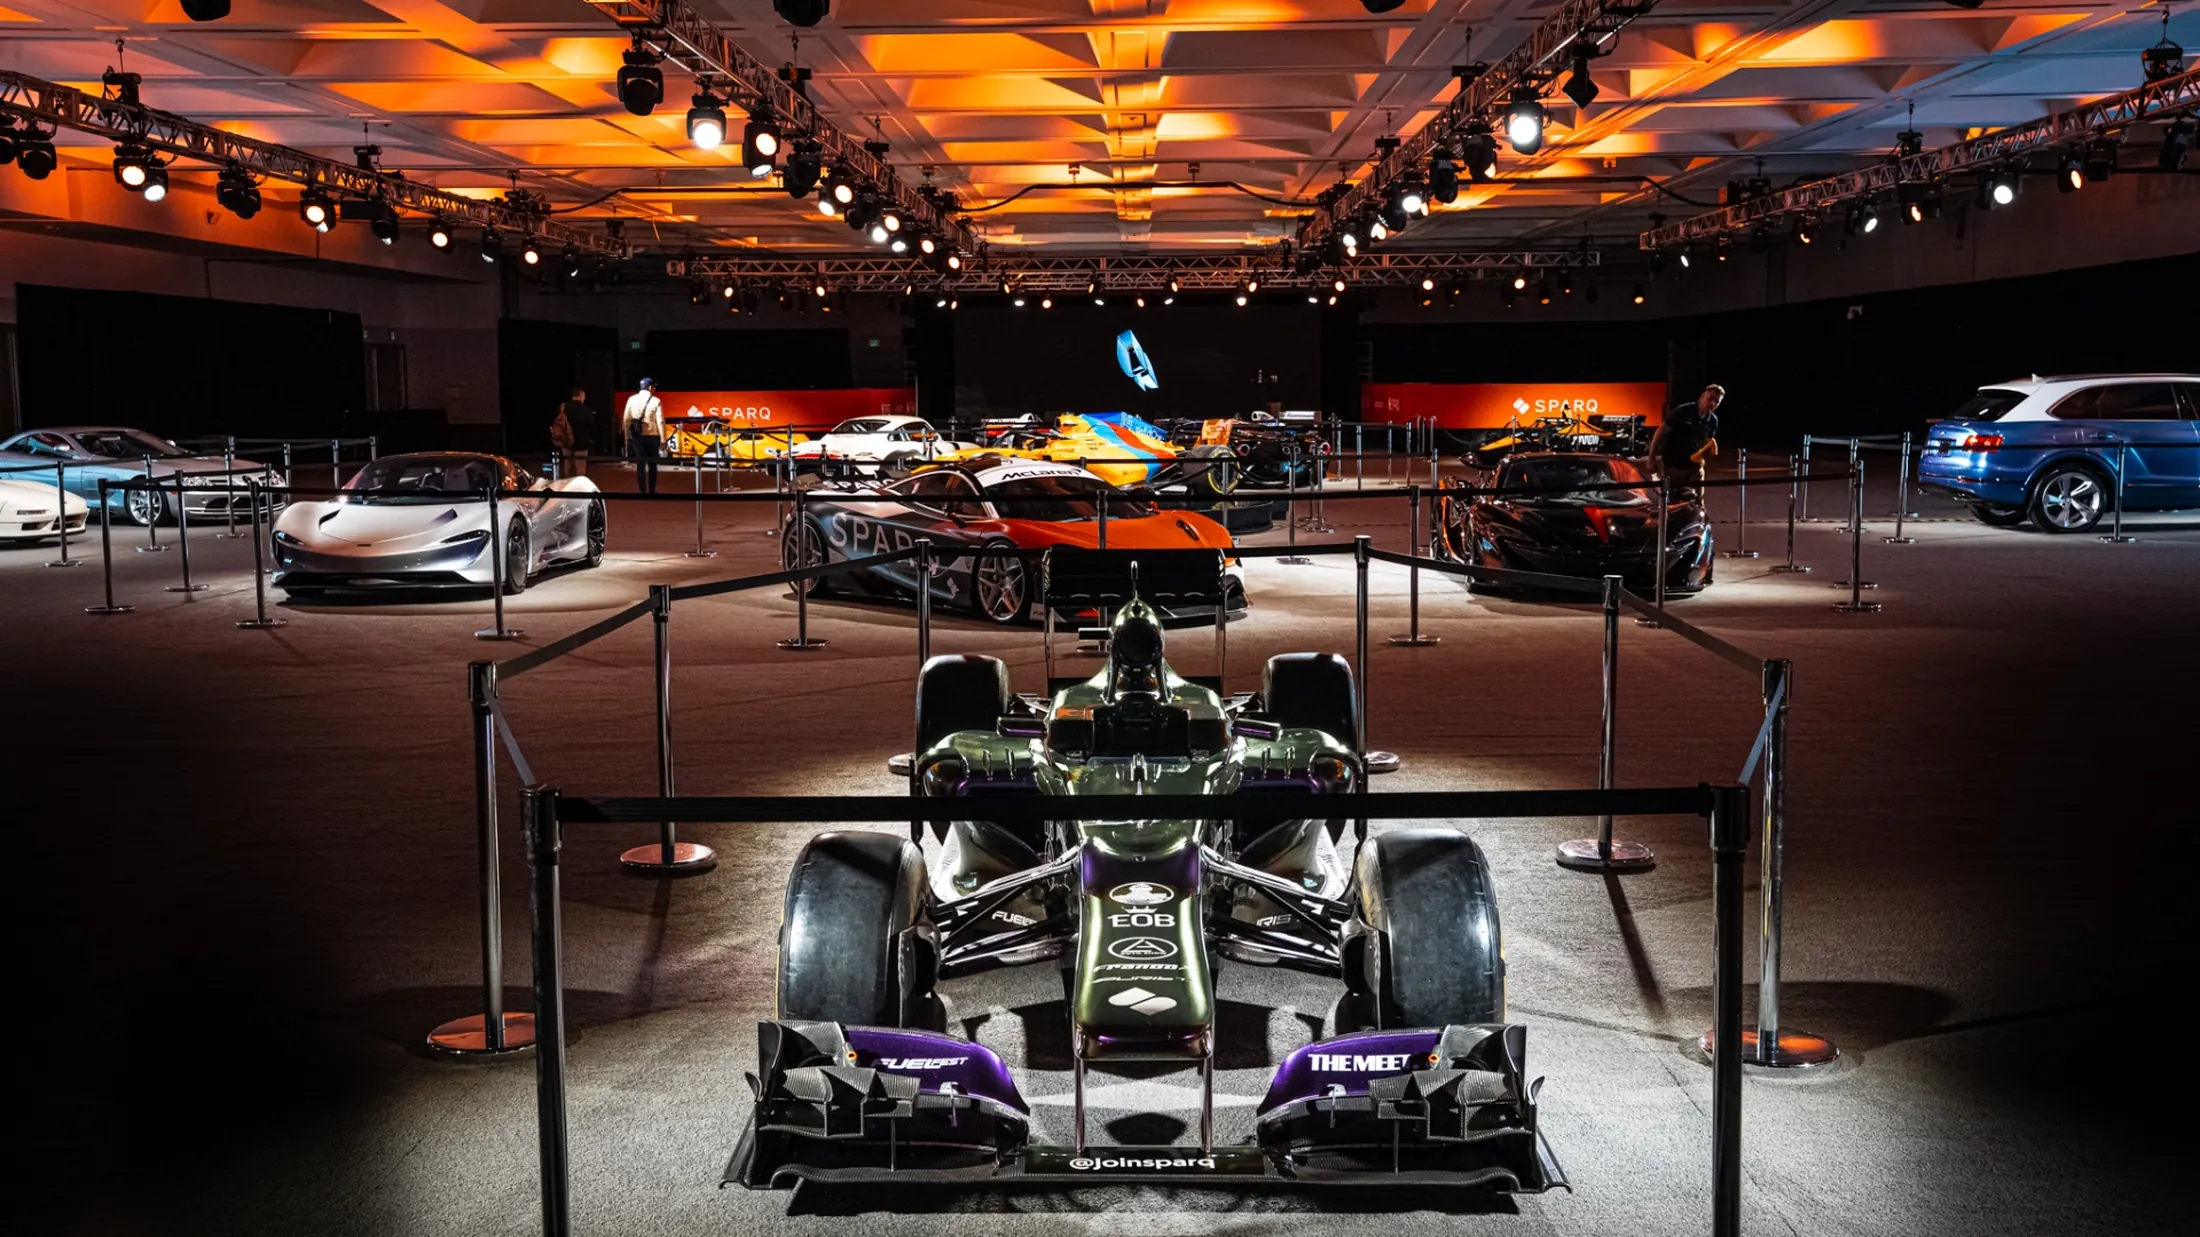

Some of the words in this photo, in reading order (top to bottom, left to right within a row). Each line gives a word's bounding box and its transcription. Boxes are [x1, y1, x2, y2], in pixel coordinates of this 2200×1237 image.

[1534, 399, 1599, 413] SPARQ
[708, 406, 772, 421] SPARQ
[1002, 468, 1082, 480] McLaren
[829, 511, 930, 570] SPAR
[1107, 913, 1176, 928] EOB
[1069, 1157, 1216, 1170] @joinsparq
